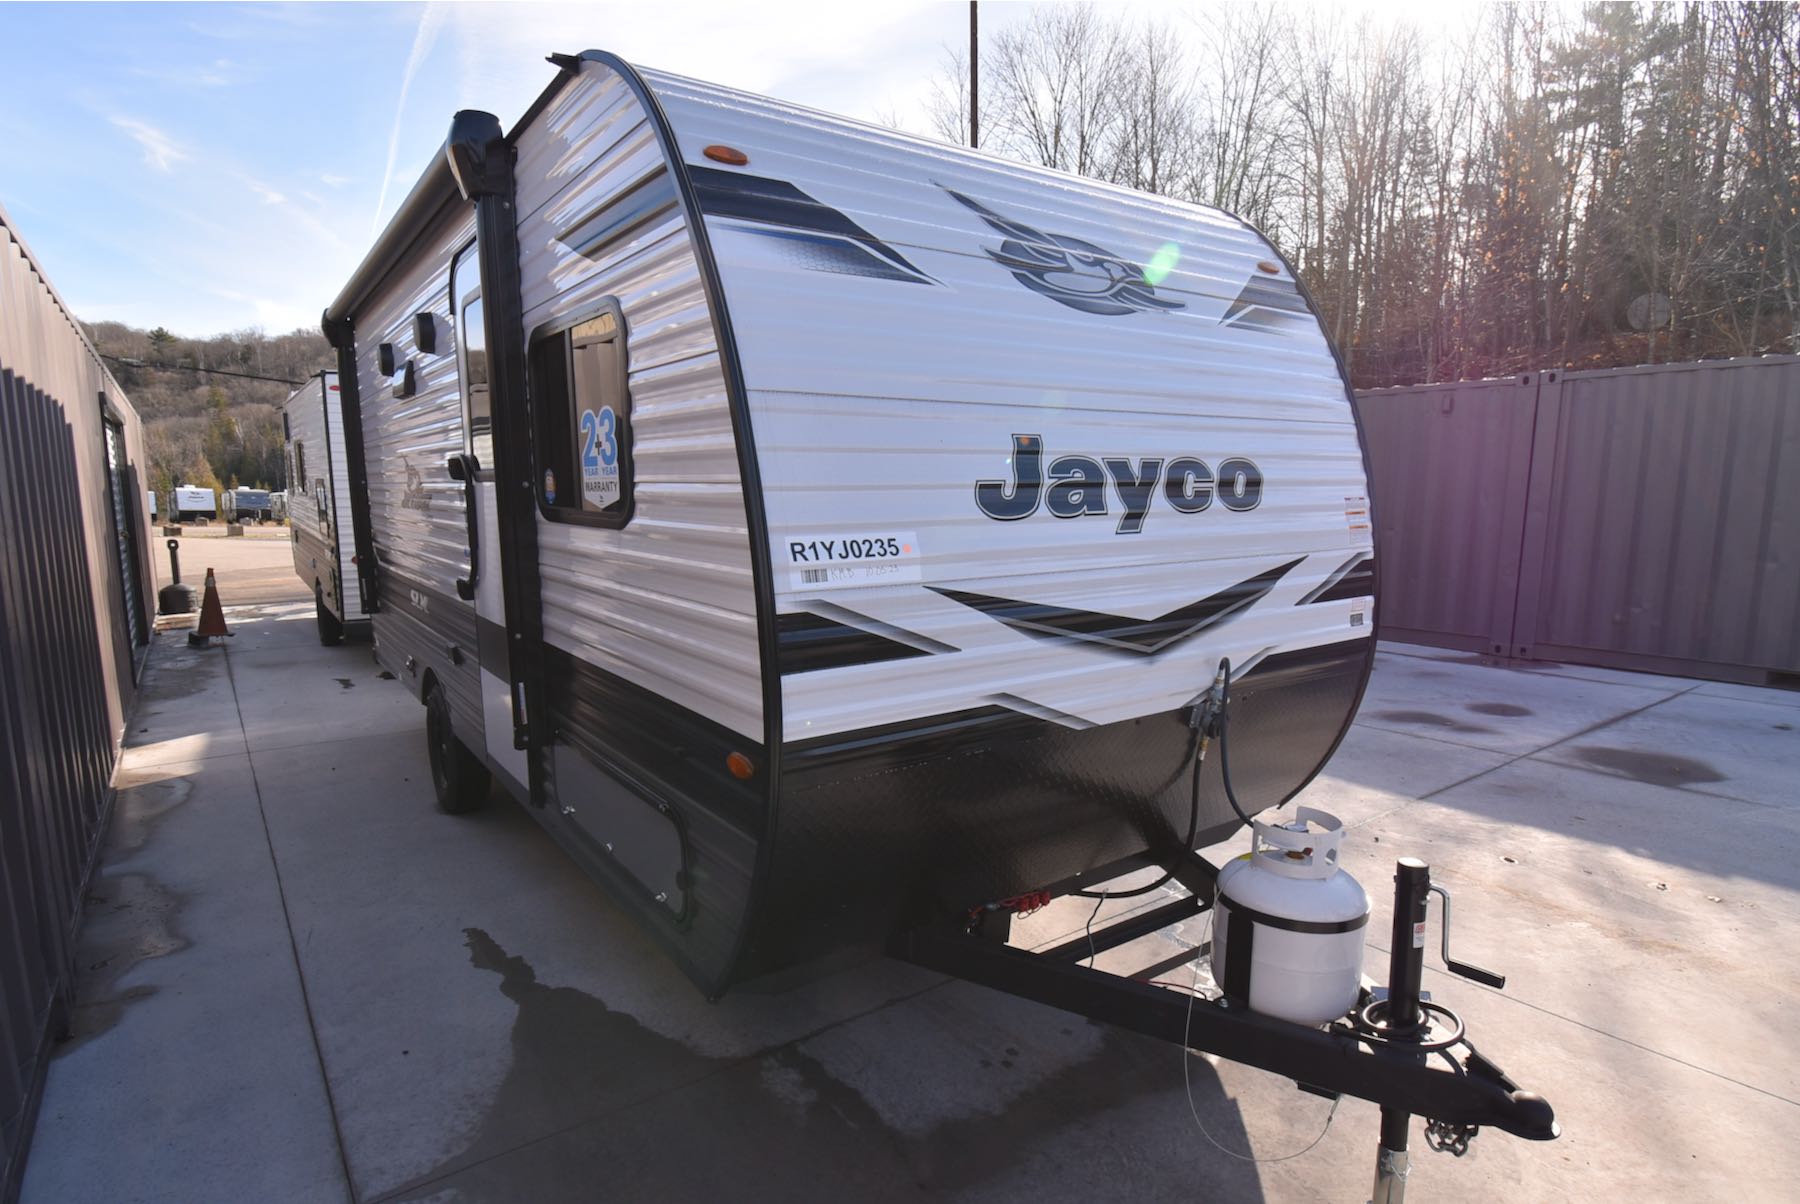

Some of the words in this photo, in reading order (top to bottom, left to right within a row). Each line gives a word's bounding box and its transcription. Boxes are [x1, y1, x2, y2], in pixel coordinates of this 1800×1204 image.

[584, 467, 598, 476] YEAR
[601, 466, 617, 475] YEAR
[585, 480, 618, 493] WARRANTY
[975, 433, 1264, 535] Jayco
[790, 538, 900, 562] R1YJ0235
